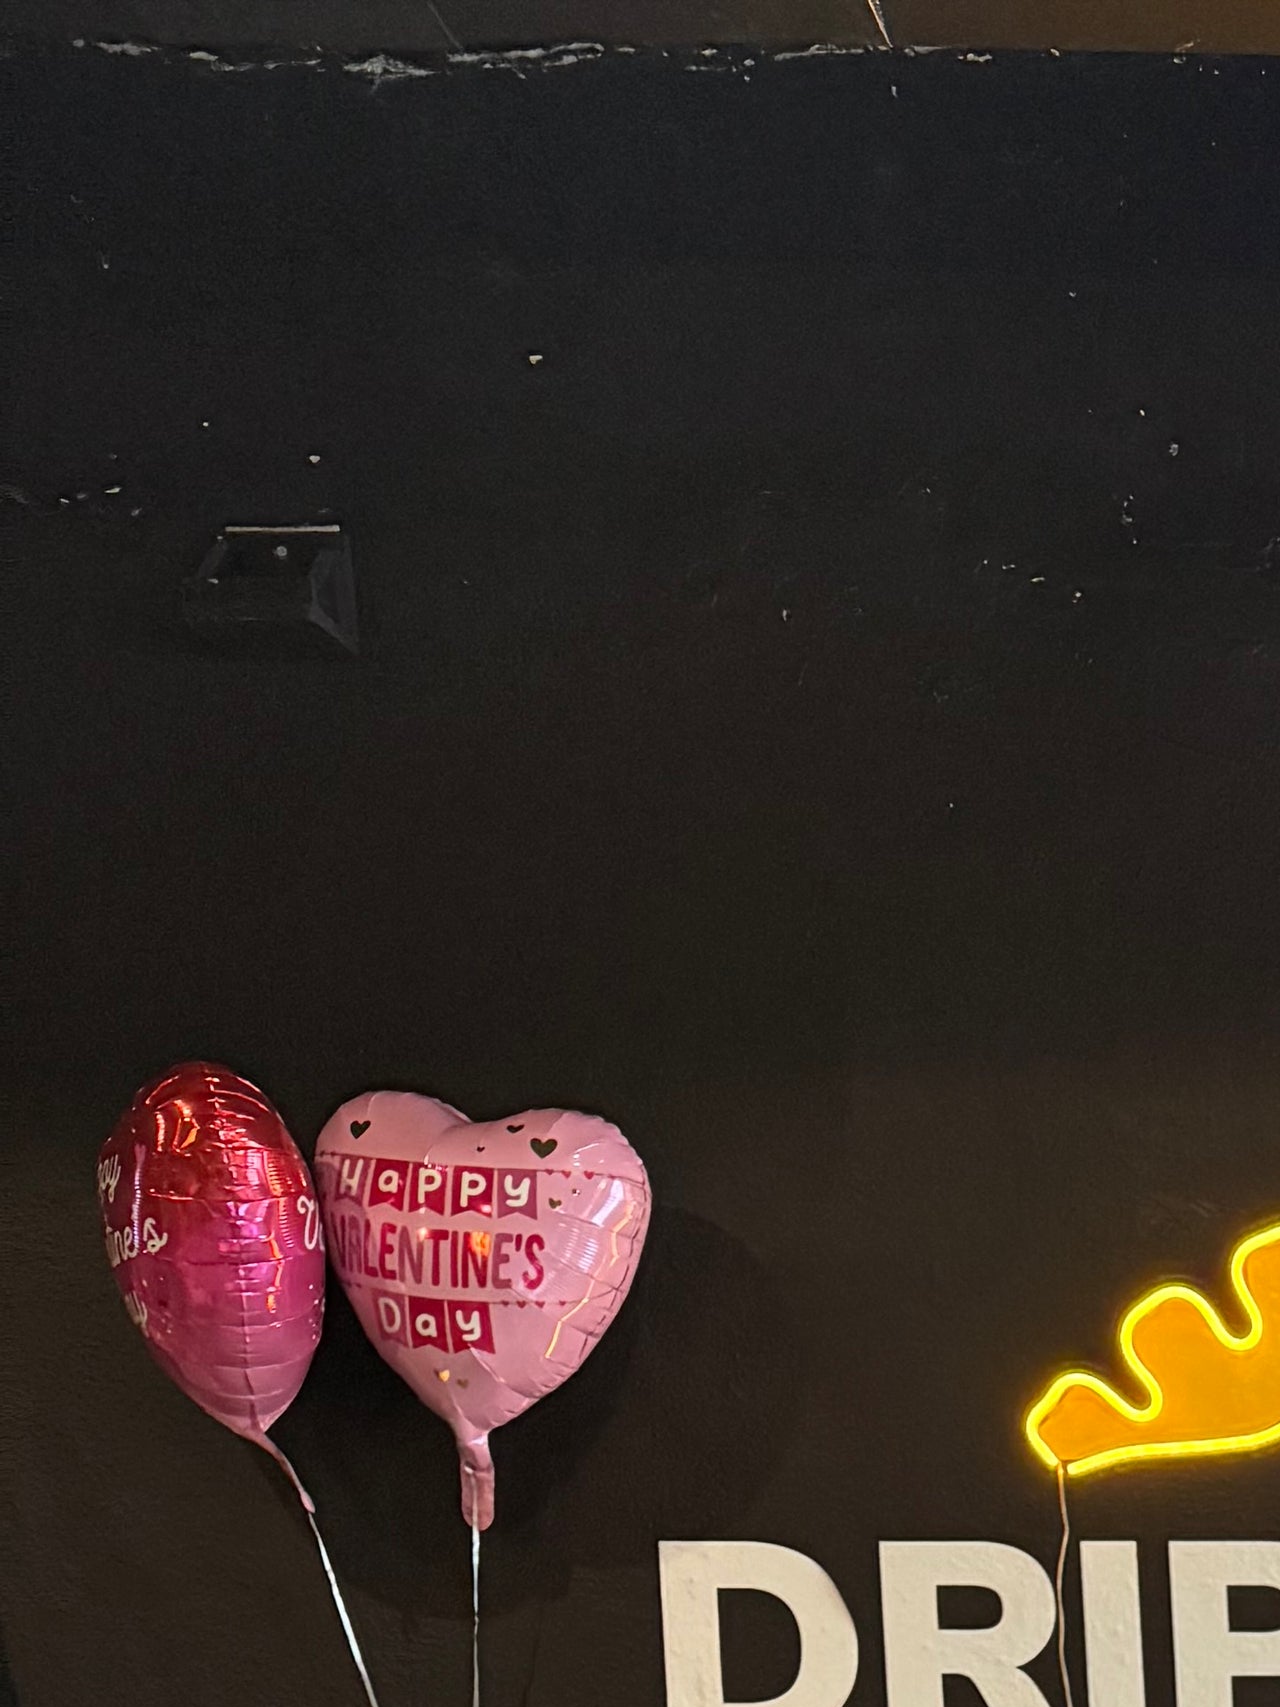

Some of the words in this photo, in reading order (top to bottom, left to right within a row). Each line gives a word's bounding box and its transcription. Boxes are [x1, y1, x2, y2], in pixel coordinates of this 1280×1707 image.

[338, 1158, 531, 1208] Happy
[331, 1210, 546, 1290] VALENTINE'S
[377, 1297, 481, 1341] Day
